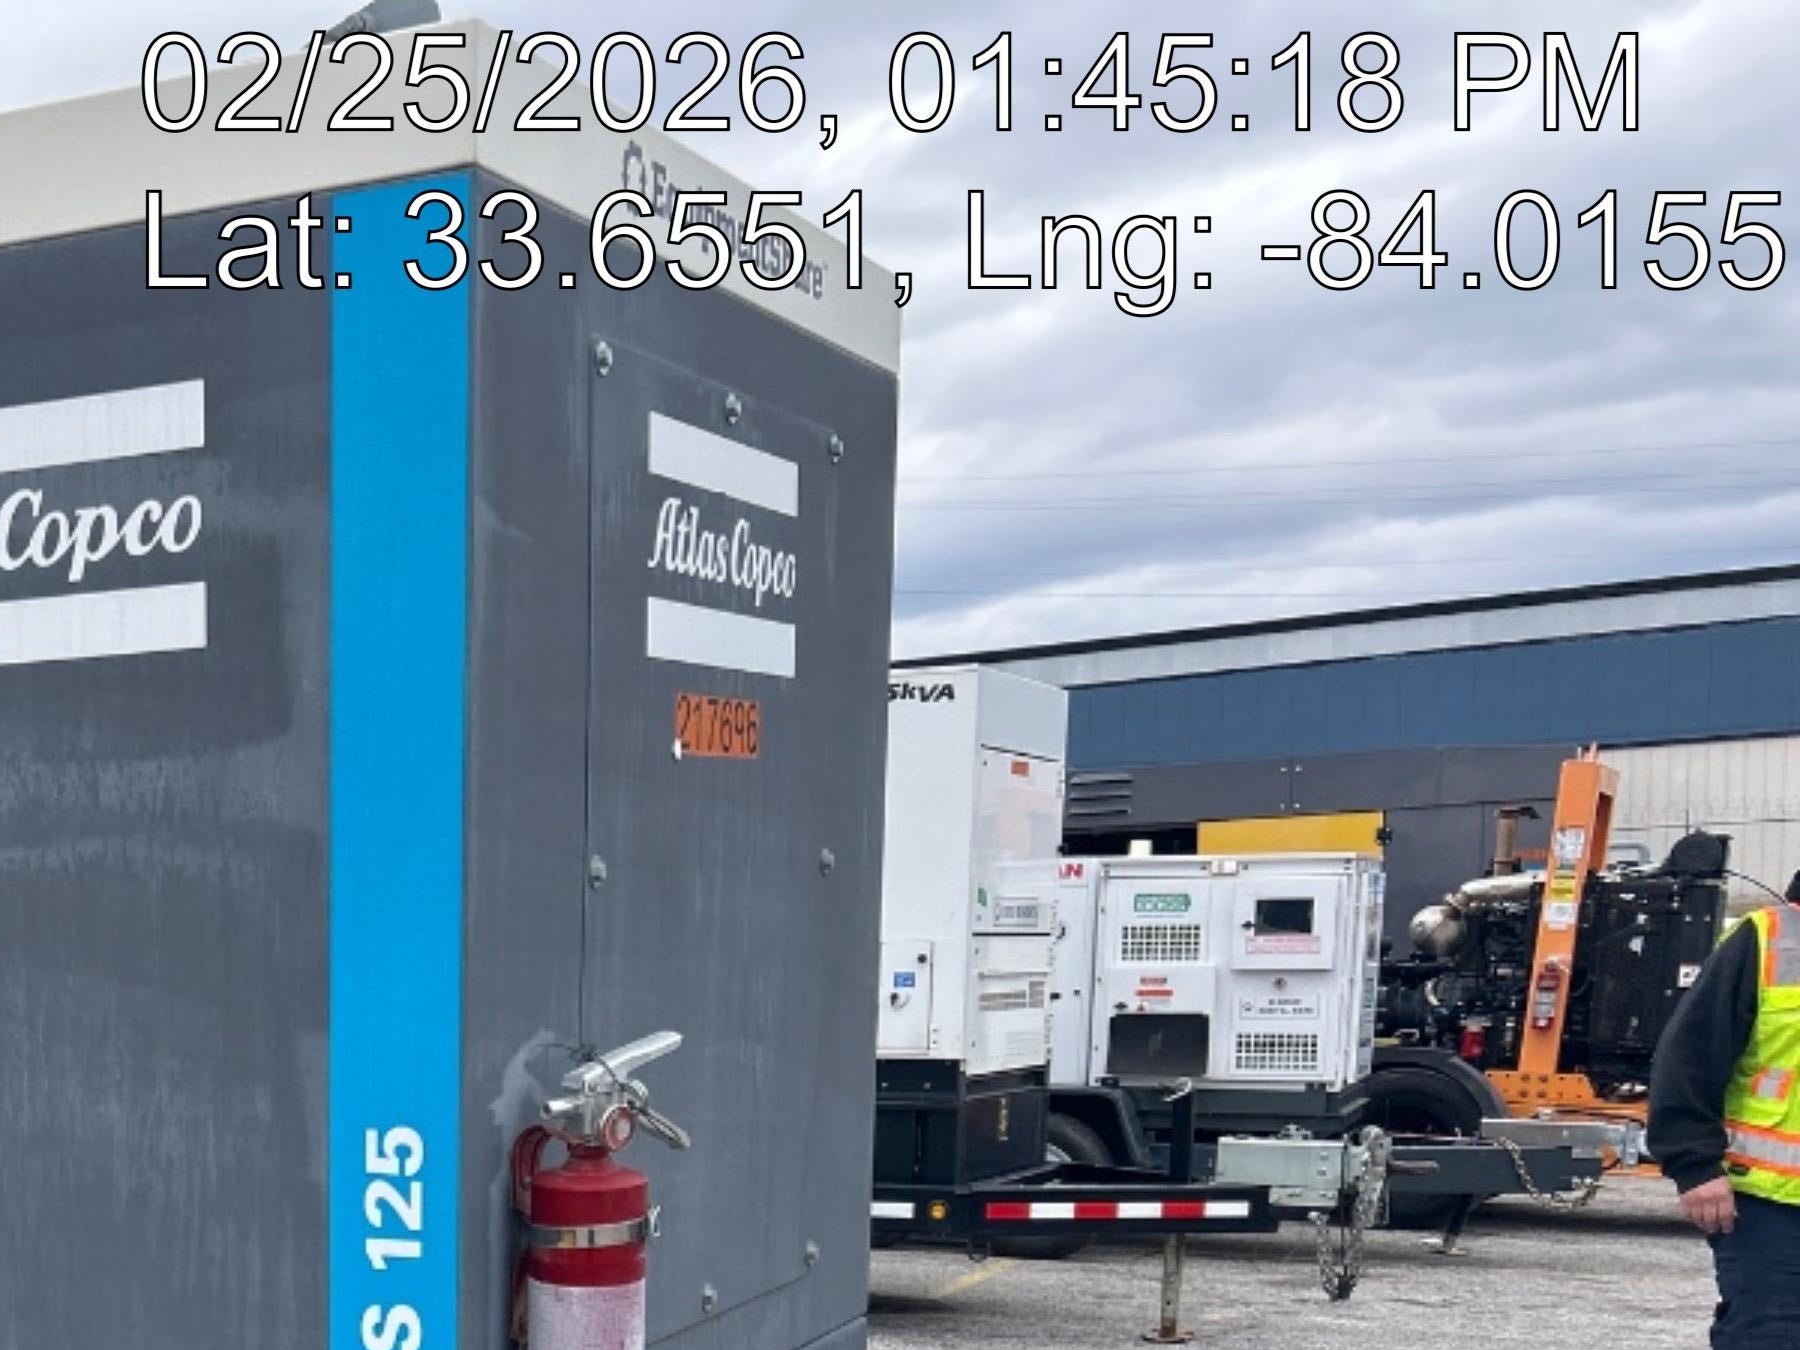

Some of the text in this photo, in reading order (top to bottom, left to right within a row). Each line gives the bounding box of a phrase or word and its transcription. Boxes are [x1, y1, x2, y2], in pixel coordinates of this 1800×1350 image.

[647, 497, 796, 607] Atlas Copco
[678, 695, 757, 753] 217696
[364, 1124, 425, 1271] 125
